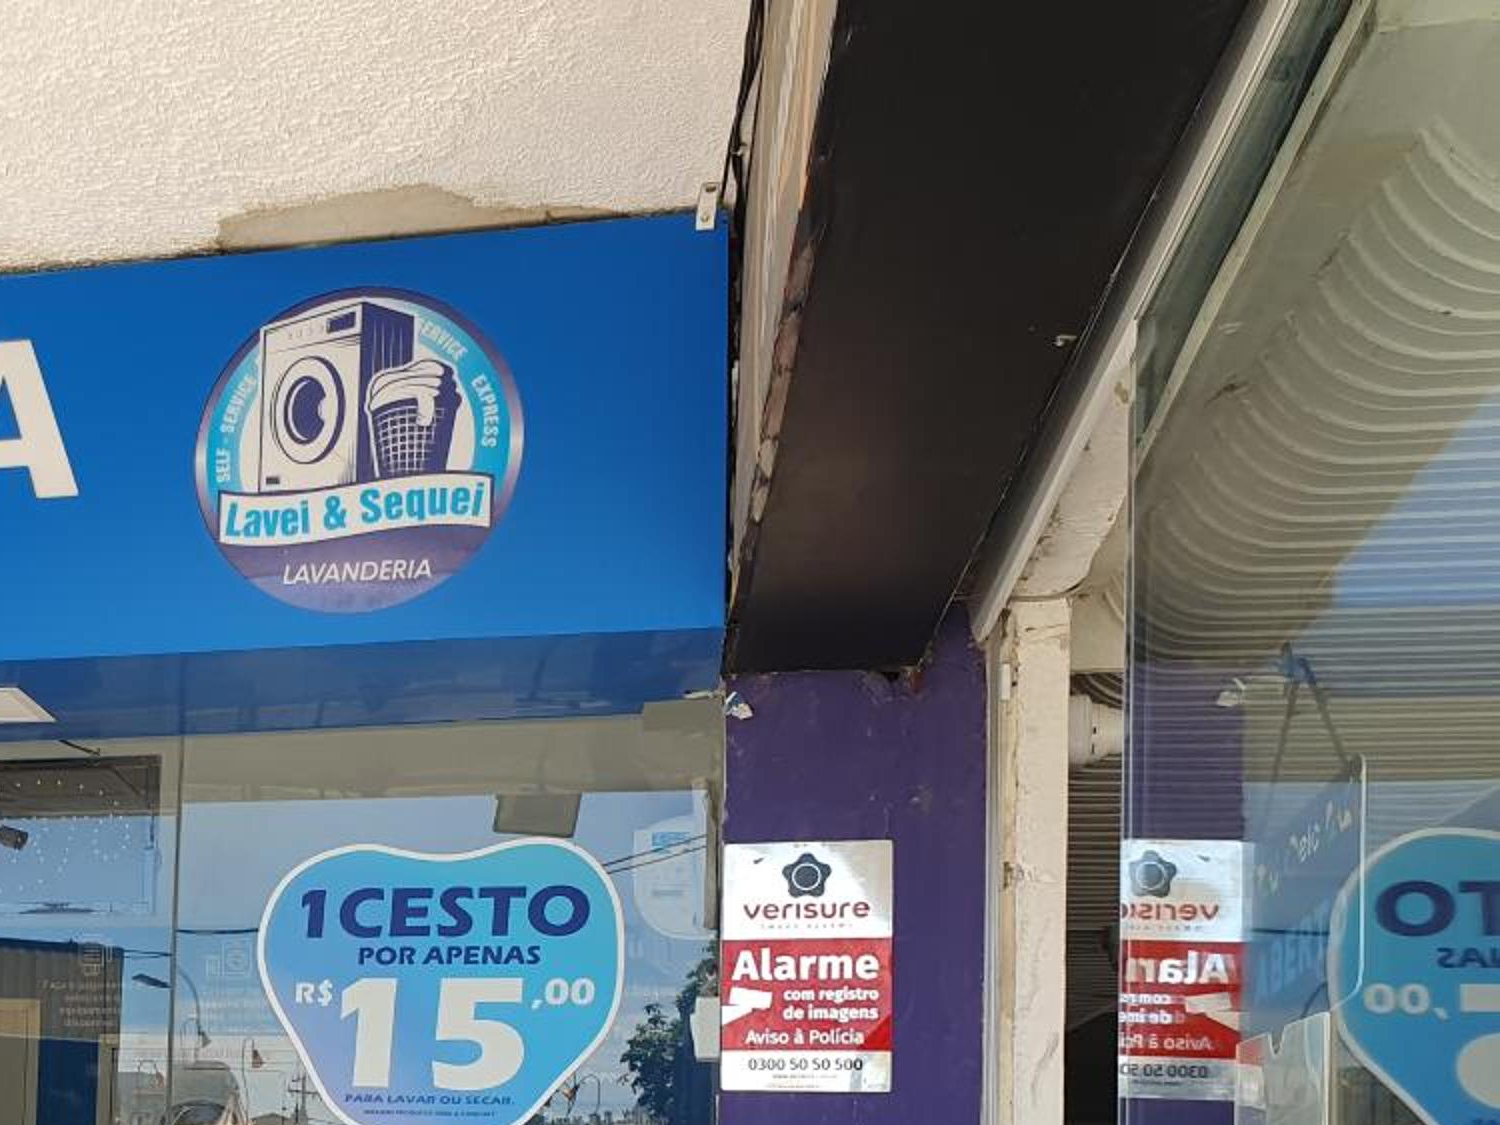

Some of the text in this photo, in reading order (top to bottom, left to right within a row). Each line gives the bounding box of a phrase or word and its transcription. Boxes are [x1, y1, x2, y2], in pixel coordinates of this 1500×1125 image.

[471, 373, 501, 449] EXPRESS
[225, 482, 485, 538] Lavei & Sequei
[282, 558, 432, 585] LAVANDERIA
[743, 901, 871, 920] verisure
[358, 945, 542, 966] POR APENAS
[731, 947, 880, 982] Alarme
[783, 986, 880, 1004] com registro
[782, 1006, 879, 1023] de imagens
[745, 1029, 789, 1045] Aviso
[809, 1028, 864, 1045] Polícia
[748, 1058, 863, 1071] 0300 50 50 500
